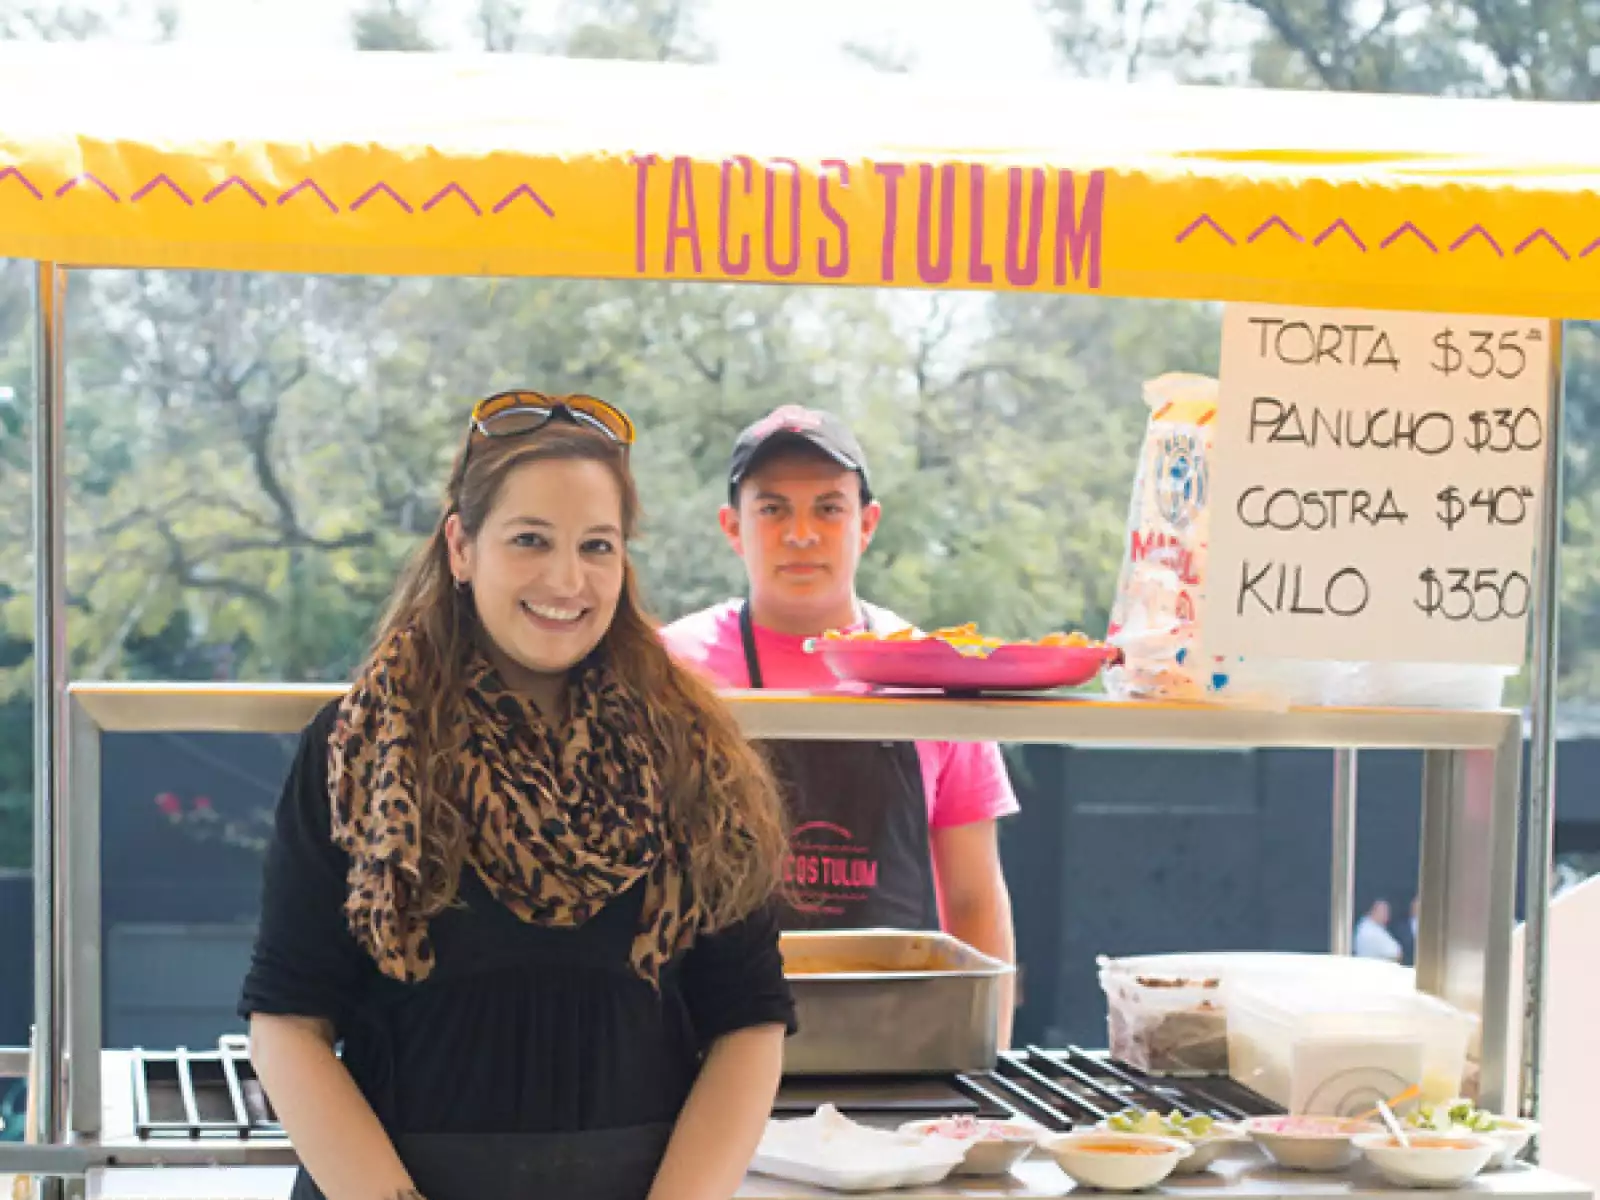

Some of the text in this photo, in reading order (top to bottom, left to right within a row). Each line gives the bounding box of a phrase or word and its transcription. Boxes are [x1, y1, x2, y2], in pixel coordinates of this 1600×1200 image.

[628, 153, 1105, 289] TACOS TULUM
[1247, 317, 1400, 371] TORTA
[1246, 396, 1543, 456] PANUCHO $30
[1236, 485, 1409, 531] COSTRA
[1235, 559, 1371, 617] KILO
[1413, 565, 1532, 622] $350
